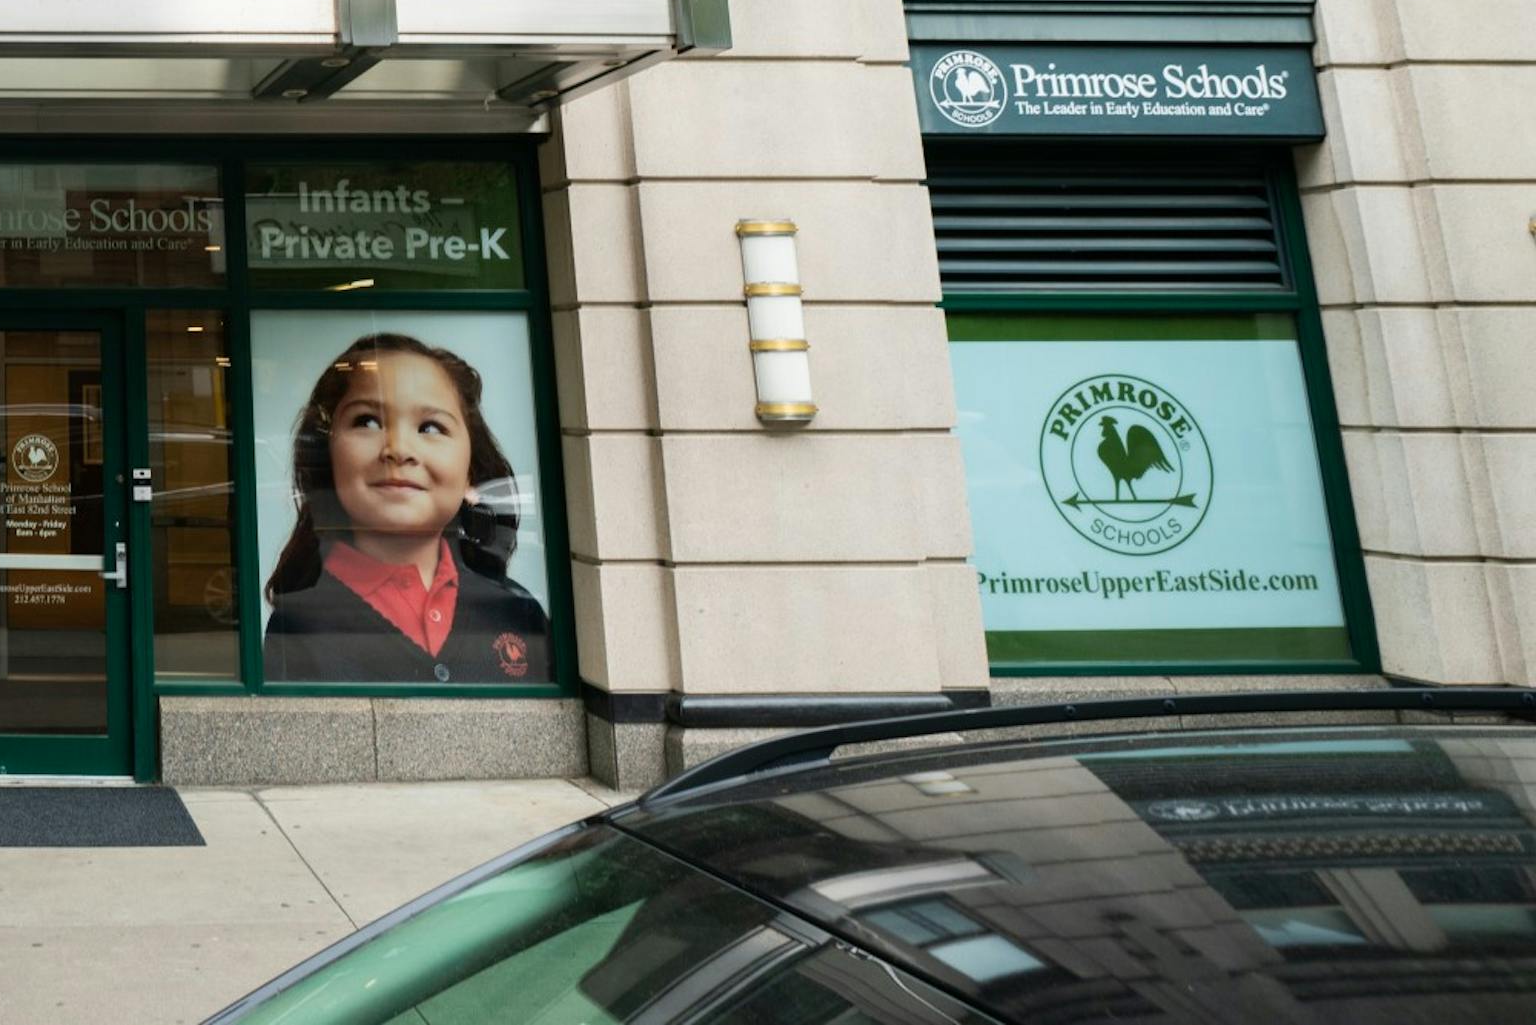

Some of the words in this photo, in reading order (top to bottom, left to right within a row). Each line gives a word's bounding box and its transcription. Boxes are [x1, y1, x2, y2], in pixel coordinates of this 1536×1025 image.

[934, 53, 998, 80] PRIMROSE
[1009, 63, 1157, 99] Primrose
[1015, 101, 1041, 115] The
[1044, 101, 1087, 115] Leader
[1090, 102, 1103, 115] in
[1107, 102, 1140, 118] Early
[1142, 102, 1205, 116] Education
[1208, 102, 1232, 116] and
[299, 179, 431, 213] Infants
[90, 198, 214, 233] Schools
[11, 236, 23, 250] in
[26, 236, 60, 254] Early
[65, 236, 127, 251] Education
[131, 236, 154, 251] and
[261, 226, 394, 260] Private
[406, 228, 510, 260] Pre-K
[1049, 381, 1193, 442] PRIMROSE
[0, 483, 40, 494] Primrose
[42, 483, 72, 494] School
[6, 494, 17, 504] of
[19, 494, 65, 504] Manhattan
[7, 505, 25, 515] East
[27, 505, 50, 515] 82nd
[52, 505, 77, 515] Street
[6, 519, 37, 530] Monday
[43, 519, 67, 531] Friday
[1090, 517, 1183, 547] SCHOOLS
[977, 569, 1319, 600] PrimroseUpperEastSide.com
